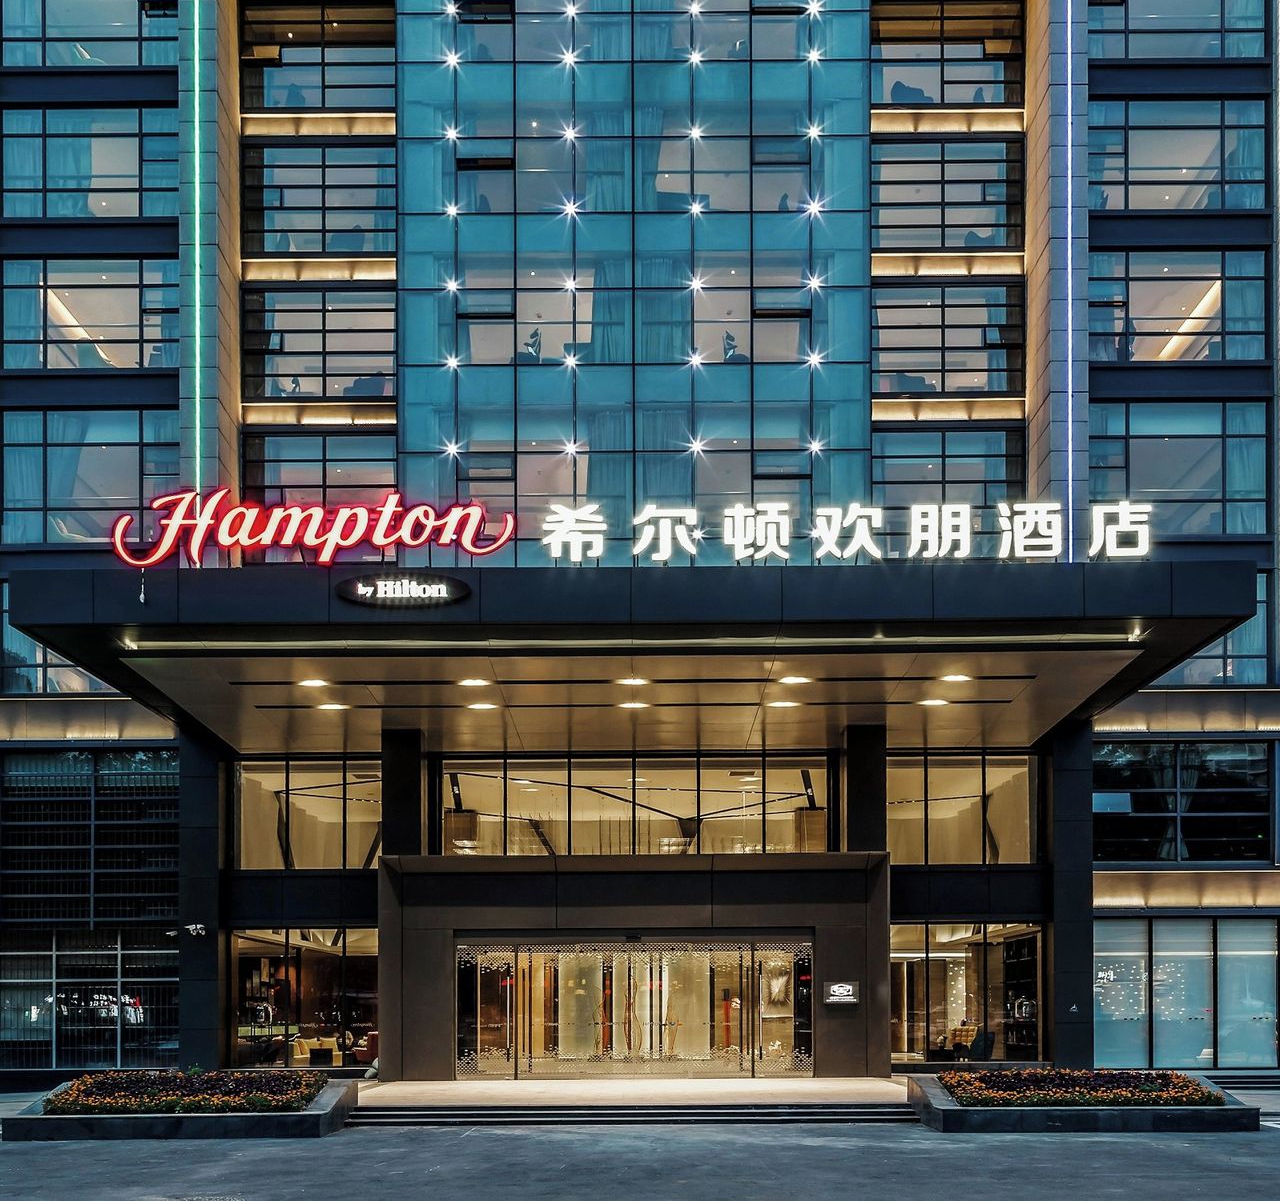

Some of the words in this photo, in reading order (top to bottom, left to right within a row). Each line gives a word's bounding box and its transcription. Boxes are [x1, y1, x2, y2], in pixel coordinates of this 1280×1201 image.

[112, 487, 517, 567] Hampton
[541, 501, 1154, 562] 希尔顿欢朋酒店
[357, 582, 375, 597] by
[376, 579, 449, 598] Hilton
